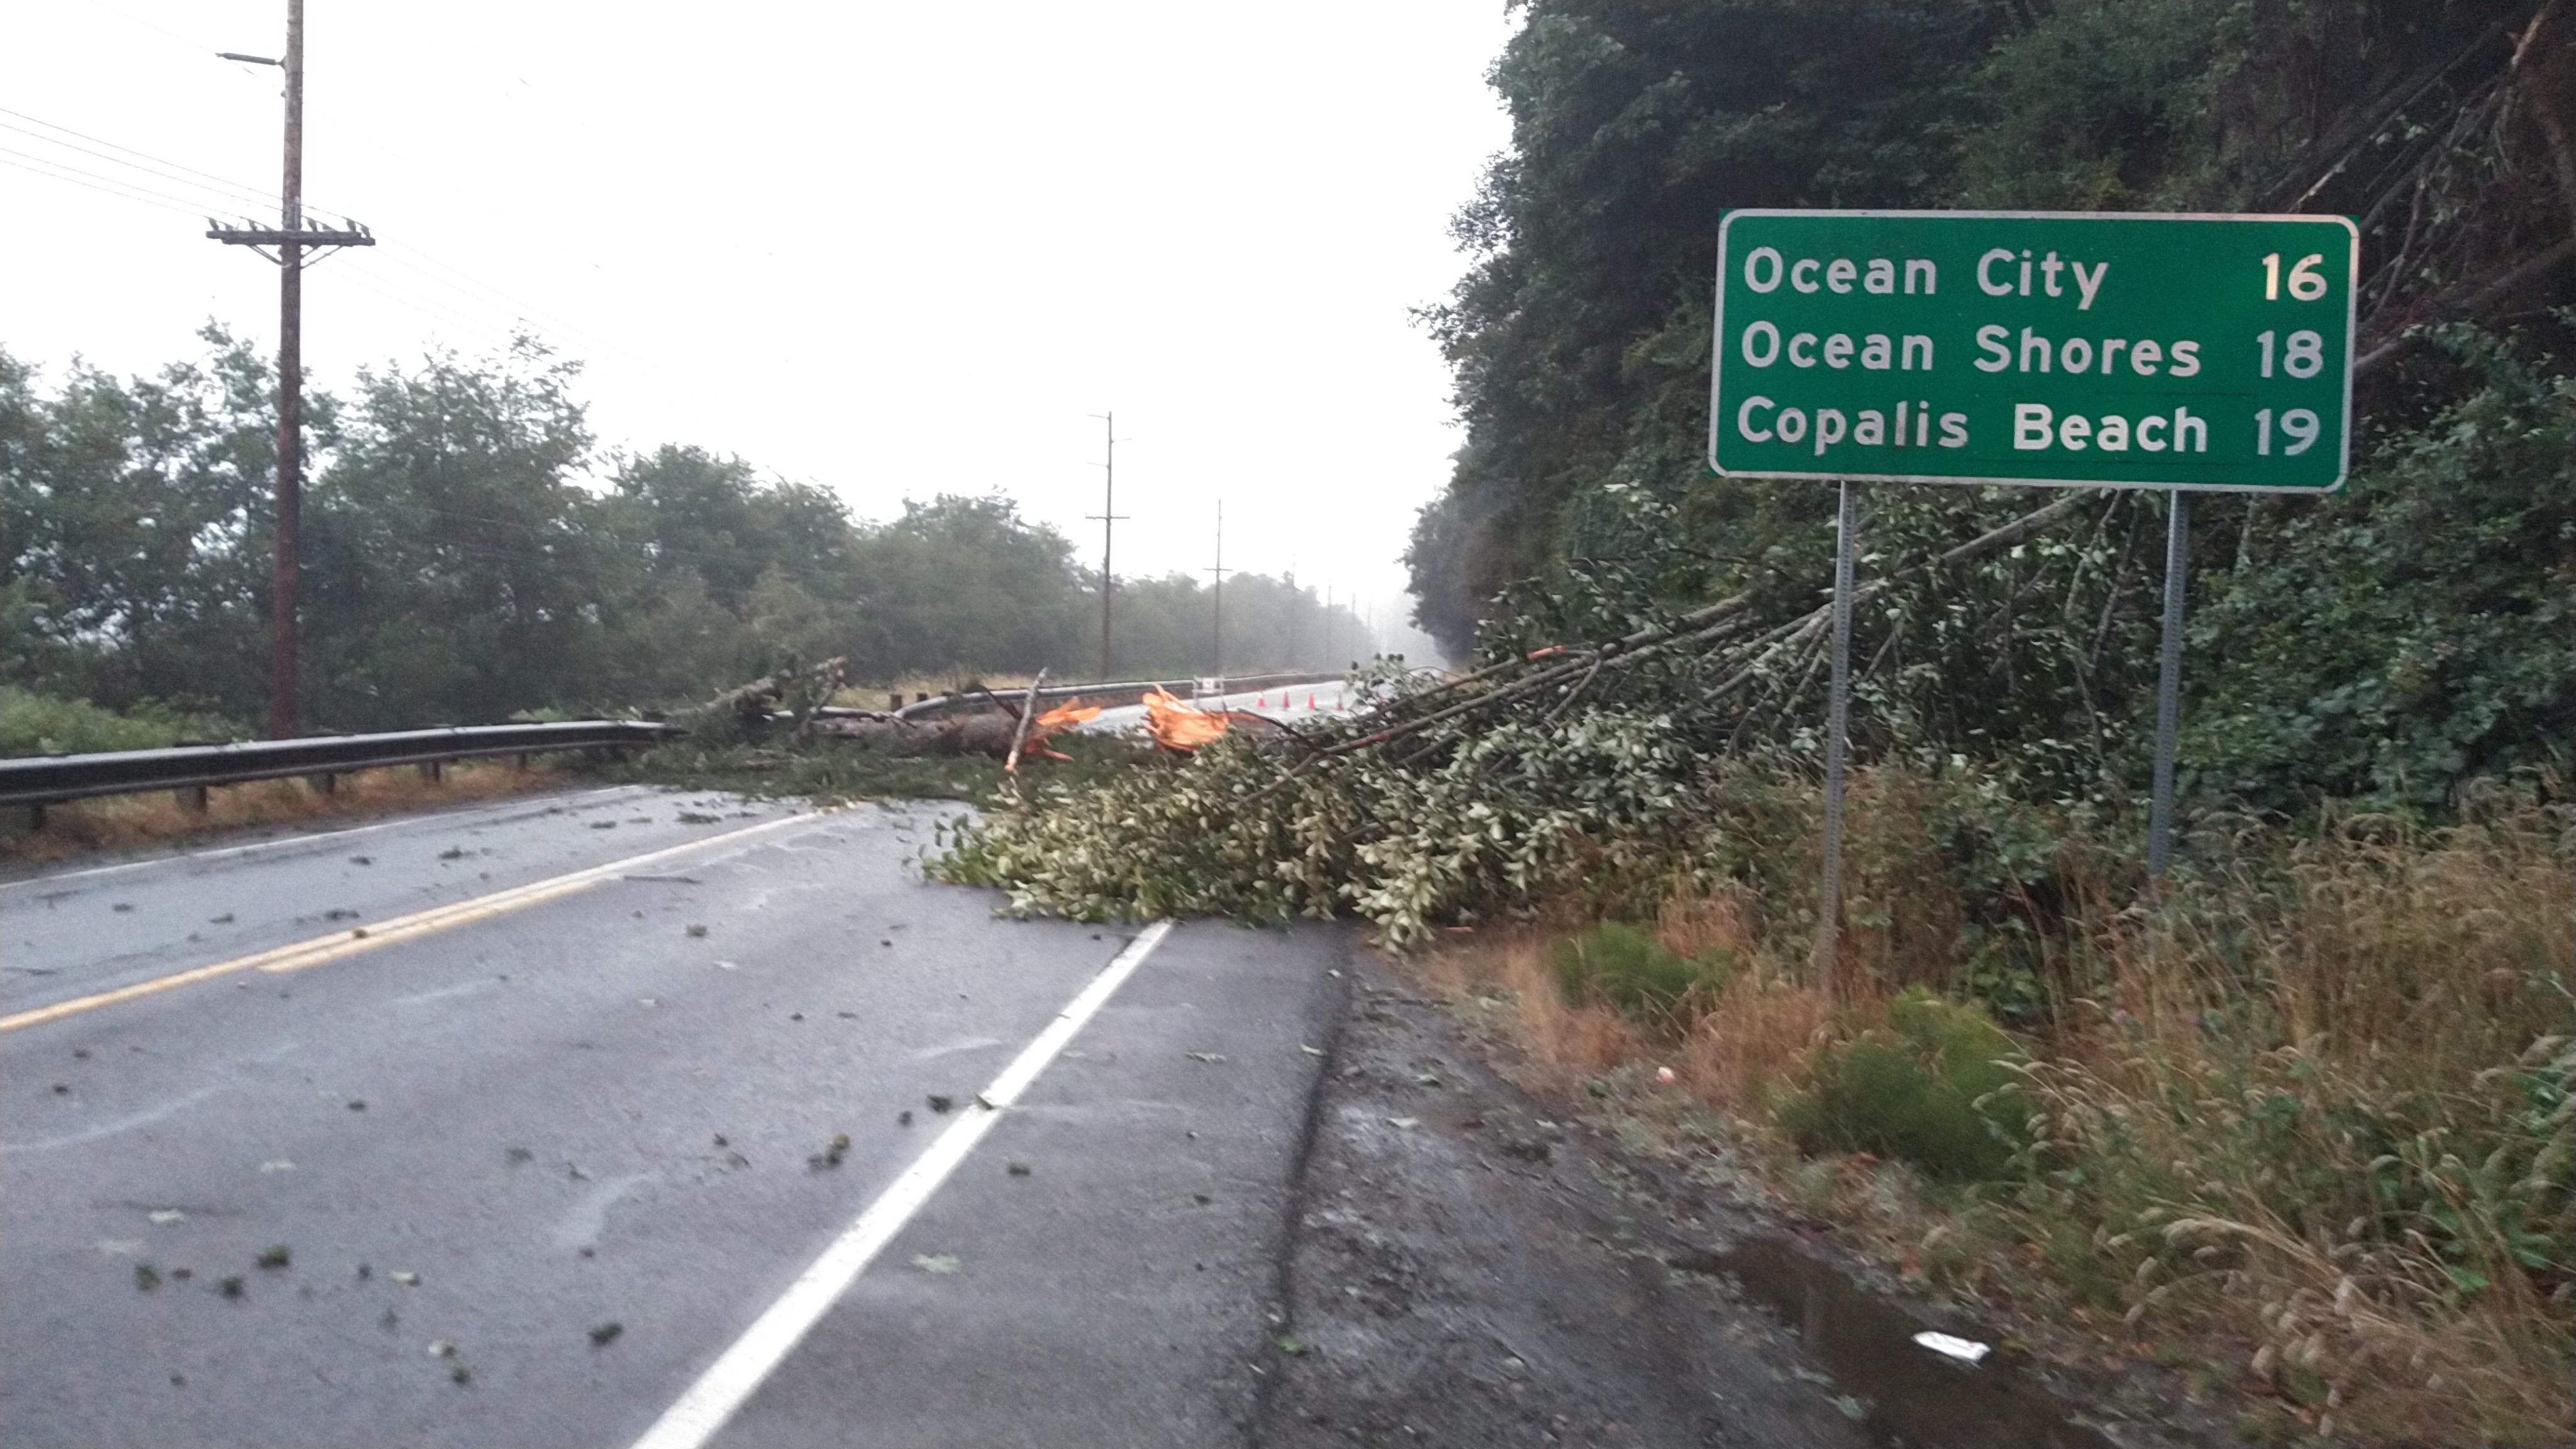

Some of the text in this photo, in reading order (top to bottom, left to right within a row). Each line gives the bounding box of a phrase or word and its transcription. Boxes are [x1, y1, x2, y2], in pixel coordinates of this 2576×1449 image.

[1744, 246, 2327, 311] Ocean City 16
[1741, 320, 2323, 378] Ocean Shores 18
[1738, 395, 2319, 458] Copalis Beach 19
